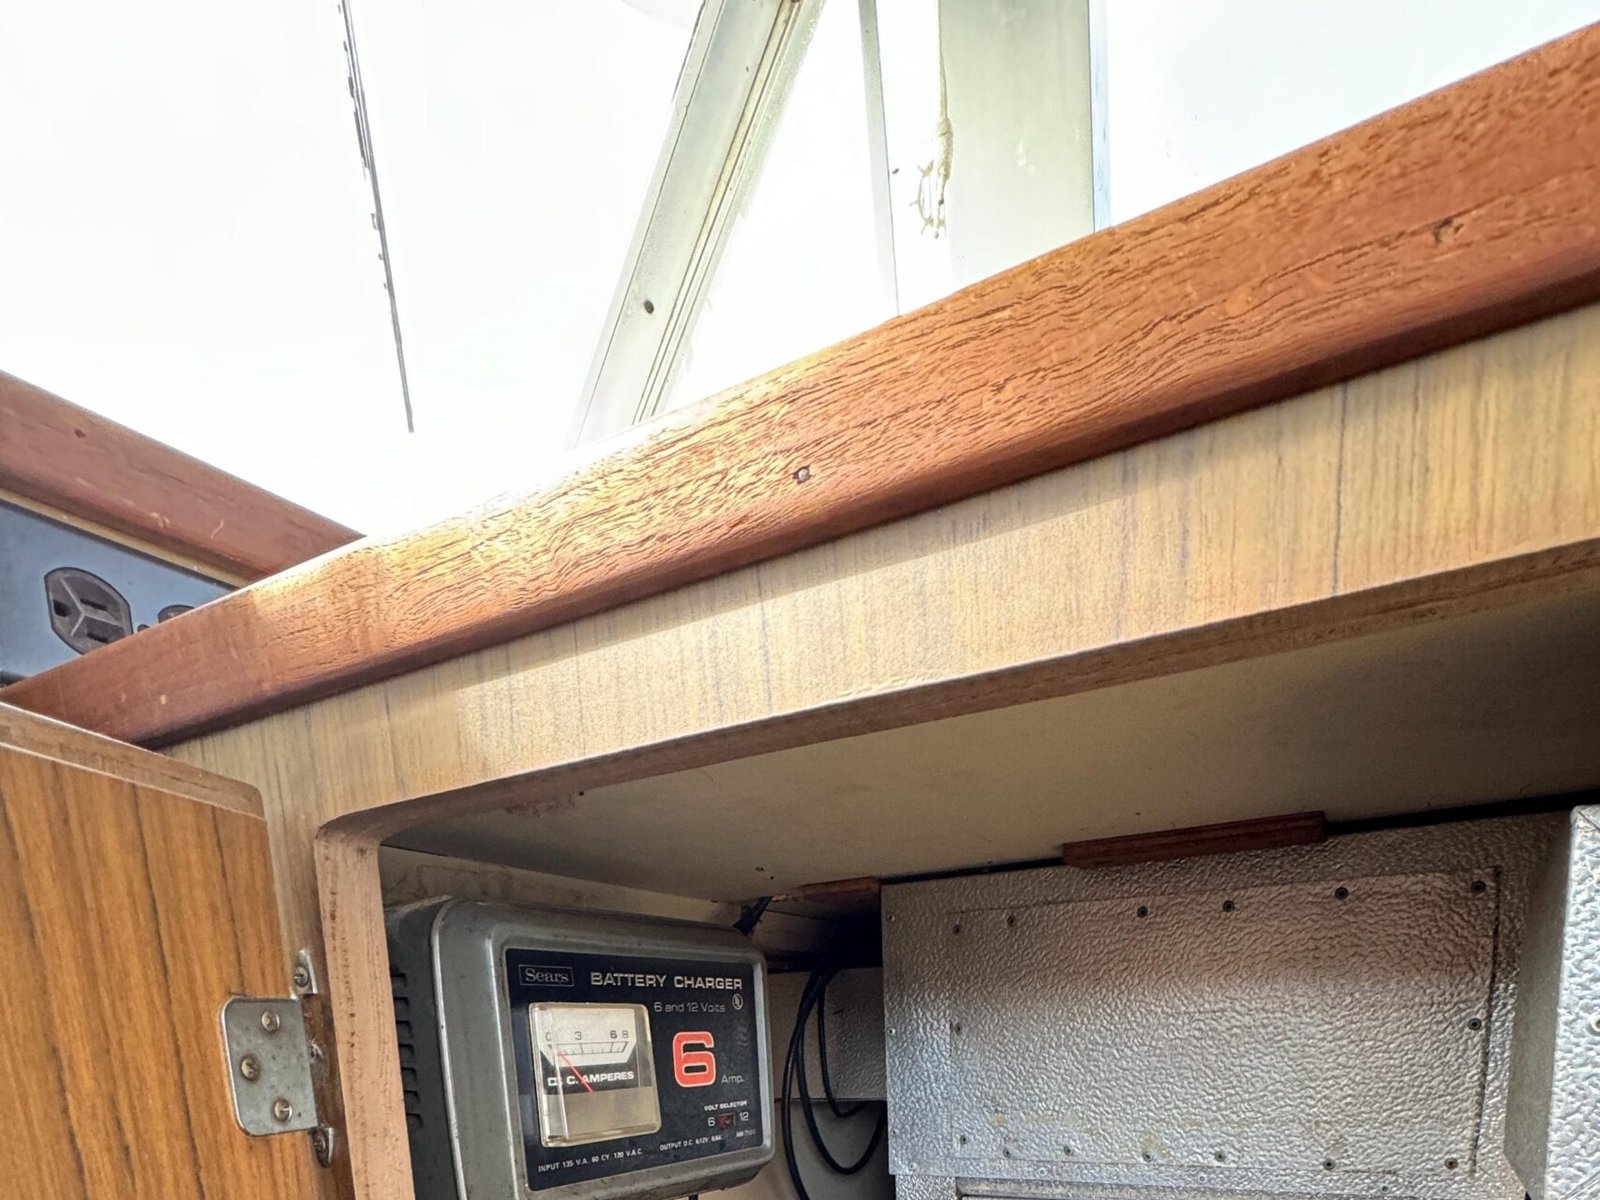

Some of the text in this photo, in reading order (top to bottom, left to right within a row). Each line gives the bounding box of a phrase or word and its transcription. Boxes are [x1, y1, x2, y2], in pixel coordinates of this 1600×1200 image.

[525, 967, 569, 985] Sears
[590, 971, 743, 990] BATTERY CHARGER
[653, 1002, 662, 1012] 6
[665, 1003, 684, 1012] and
[687, 1002, 698, 1012] 12
[702, 1002, 726, 1013] Volts
[574, 1031, 582, 1040] 3
[610, 1030, 617, 1039] 6
[622, 1030, 629, 1039] 8
[672, 1031, 716, 1088] 6
[581, 1071, 635, 1084] AMPERES
[704, 1100, 748, 1111] VOLT SELECTOR
[707, 1111, 749, 1127] 6 12
[659, 1141, 681, 1151] OUTPUT
[538, 1162, 560, 1173] INPUT
